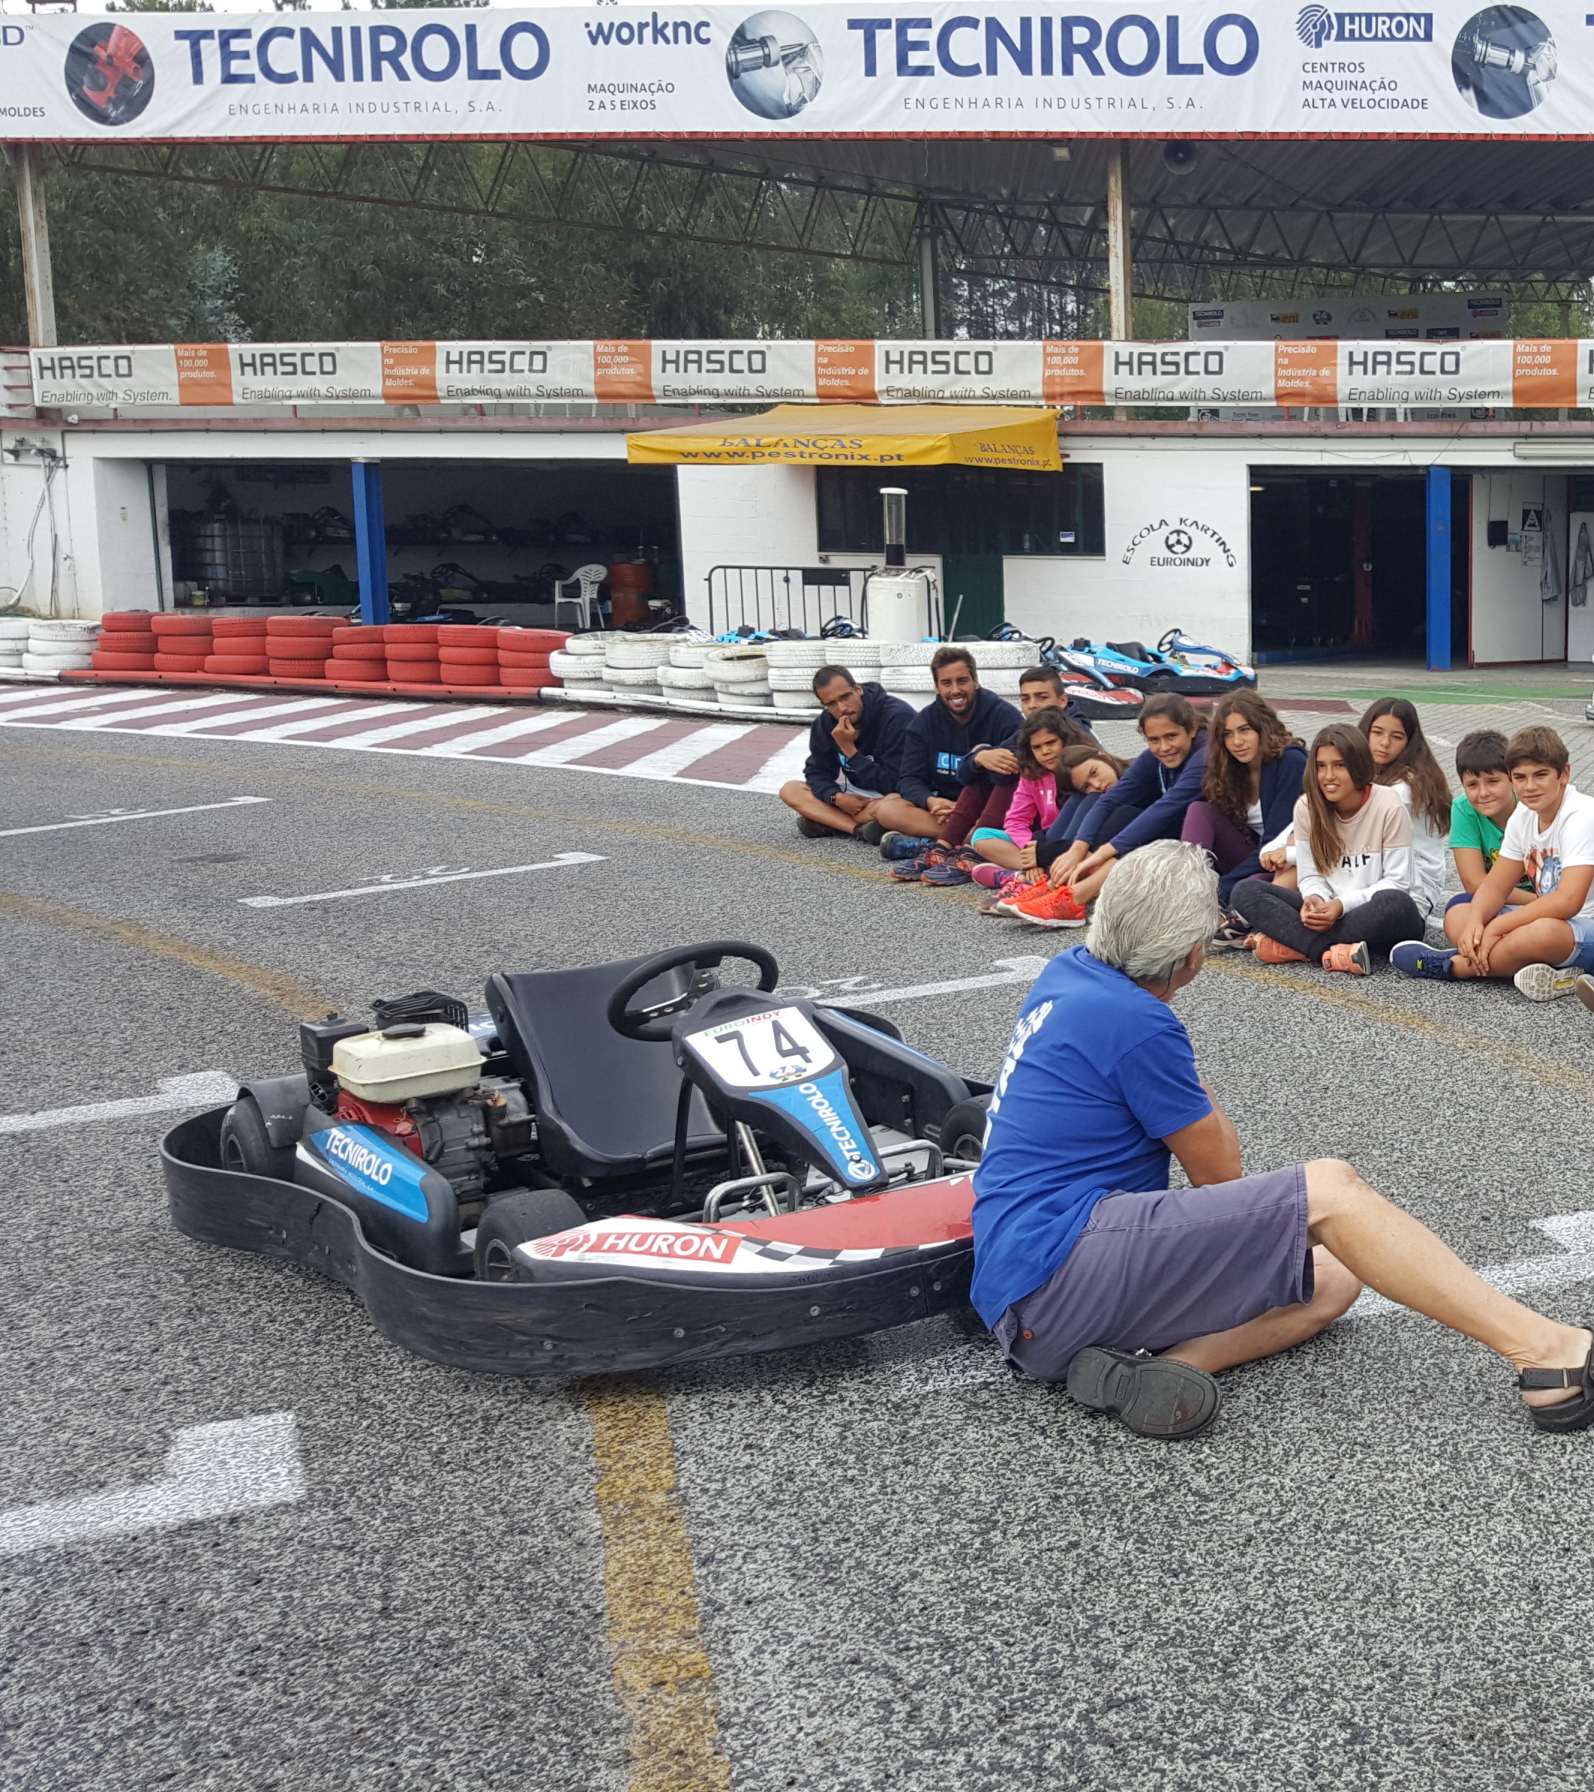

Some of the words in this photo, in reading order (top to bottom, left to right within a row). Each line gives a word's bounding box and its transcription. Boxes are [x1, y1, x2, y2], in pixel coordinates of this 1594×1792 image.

[584, 11, 711, 45] worknc
[1344, 16, 1425, 38] HURON
[847, 13, 1259, 77] TECNIROLO
[174, 21, 550, 85] TECNIROLO
[1302, 62, 1365, 73] CENTROS
[587, 80, 675, 96] MAQUINAÇÃO
[1302, 77, 1398, 94] MAQUINAÇÃO
[228, 103, 340, 116] ENGENHARIA
[348, 101, 459, 114] INDUSTRIAL,
[468, 100, 503, 112] S.A.
[588, 100, 595, 111] 2
[598, 100, 606, 110] A
[610, 100, 616, 110] 5
[620, 99, 656, 110] EIXOS
[904, 98, 1024, 110] ENGENHARIA
[1035, 97, 1157, 111] INDUSTRIAL,
[1166, 96, 1204, 109] S.A.
[1302, 98, 1337, 109] ALTA
[1341, 98, 1428, 109] VELOCIDADE
[177, 349, 194, 357] Mais
[197, 349, 207, 357] de
[384, 345, 417, 354] Precisão
[596, 345, 615, 353] Mais
[617, 345, 628, 353] de
[818, 345, 855, 353] Precisão
[1046, 345, 1067, 353] Mais
[1070, 345, 1080, 353] de
[1278, 345, 1317, 354] Precisão
[1515, 344, 1536, 352] Mais
[1539, 344, 1551, 352] de
[38, 355, 132, 379] HASCO
[239, 352, 337, 376] HASCO
[384, 357, 394, 365] na
[446, 351, 547, 373] HASCO
[661, 350, 767, 374] HASCO
[818, 356, 828, 364] na
[885, 351, 993, 375] HASCO
[1114, 351, 1224, 375] HASCO
[1279, 357, 1289, 365] na
[1348, 351, 1460, 375] HASCO
[421, 367, 430, 376] de
[858, 366, 869, 376] de
[1319, 367, 1330, 377] de
[41, 391, 93, 405] Enabling
[96, 390, 117, 400] with
[242, 387, 292, 400] Enabling
[296, 386, 320, 399] with
[447, 386, 500, 399] Enabling
[504, 385, 531, 397] with
[663, 385, 719, 399] Enabling
[723, 384, 750, 397] with
[886, 386, 944, 398] Enabling
[950, 386, 978, 398] with
[1115, 387, 1174, 400] Enabling
[1179, 387, 1206, 400] with
[1349, 388, 1409, 402] Enabling
[1415, 387, 1442, 400] with
[681, 449, 904, 463] www.pestronix.pt
[979, 442, 1035, 456] BALANÇAS
[965, 456, 1052, 468] www.pestronix.pt
[1122, 518, 1169, 565] ESCOLA
[1179, 517, 1237, 567] KARTING
[1150, 556, 1211, 567] EUROINDY
[704, 1010, 781, 1037] EUROINDY
[715, 1020, 812, 1077] 74
[799, 1083, 858, 1162] TECNIROLO
[326, 1128, 393, 1185] TECNIROLO
[602, 1233, 728, 1259] HURON
